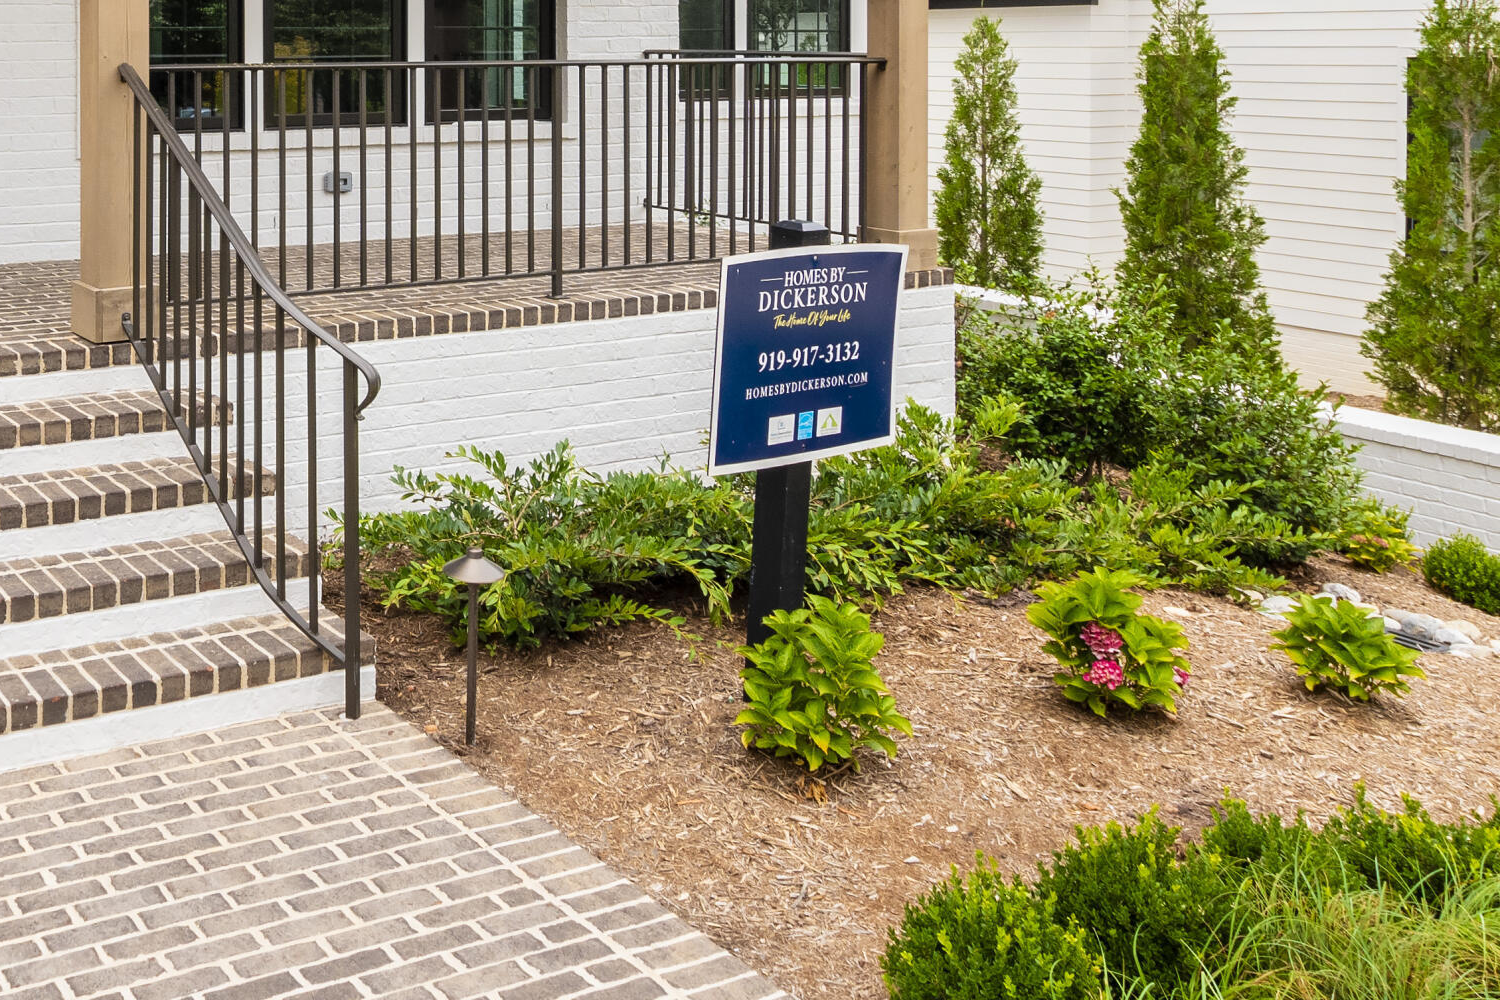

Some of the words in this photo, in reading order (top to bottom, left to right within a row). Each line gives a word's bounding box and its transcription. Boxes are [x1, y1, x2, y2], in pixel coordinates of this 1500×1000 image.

[784, 268, 828, 287] HOMES
[829, 266, 846, 283] BY
[758, 282, 868, 312] DICKERSON
[773, 313, 786, 330] The
[786, 312, 807, 328] Home
[807, 311, 819, 326] Of
[819, 309, 838, 327] Your
[837, 308, 851, 323] Life
[758, 340, 860, 373] 919-917-3132
[745, 371, 868, 400] HOMESBYDICKERSON.COM
